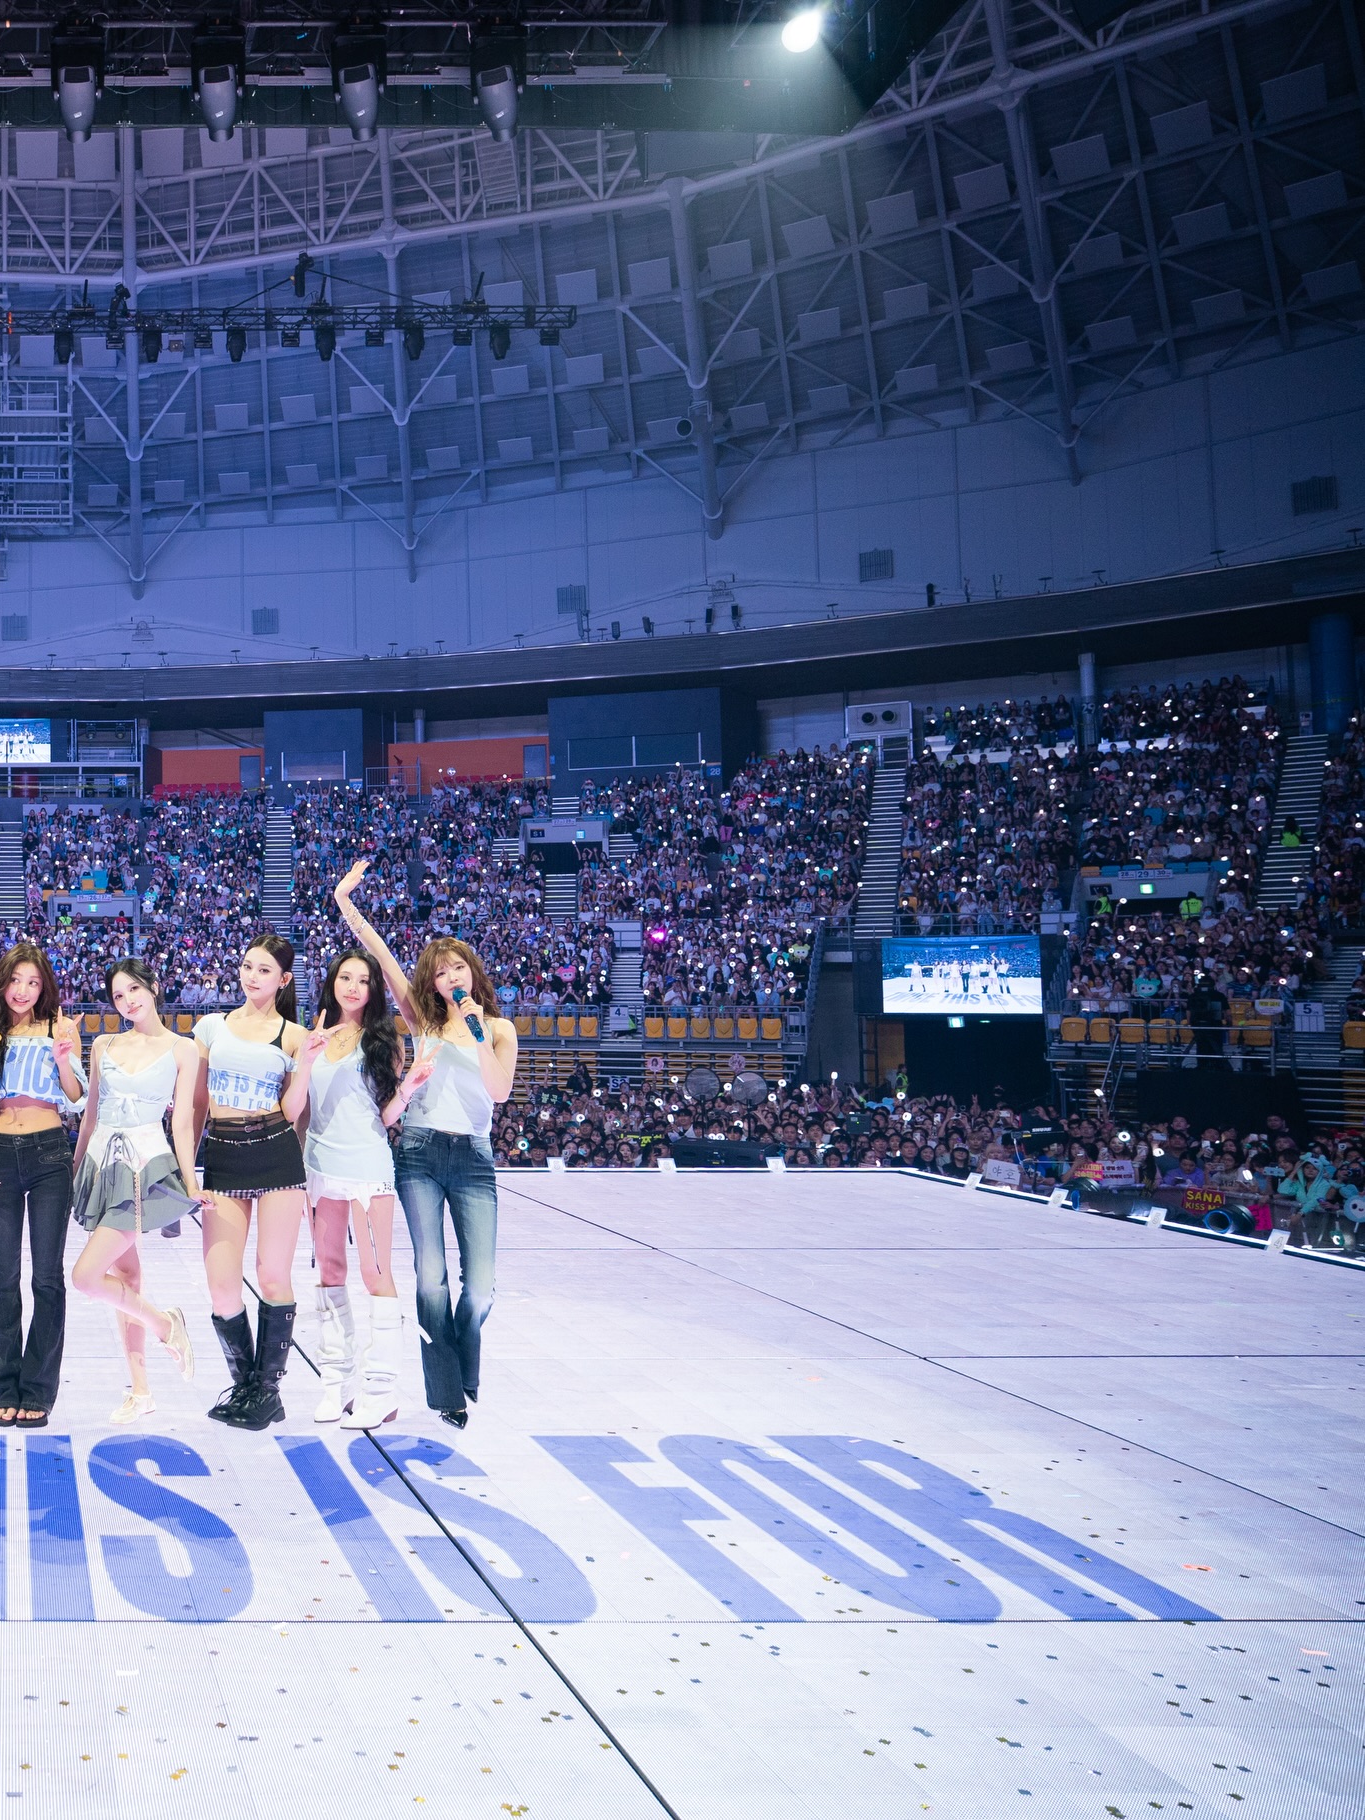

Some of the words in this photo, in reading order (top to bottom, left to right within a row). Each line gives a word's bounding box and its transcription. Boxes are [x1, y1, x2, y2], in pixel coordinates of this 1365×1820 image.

[1082, 702, 1096, 714] 29
[710, 767, 721, 776] 28
[117, 778, 127, 786] 26
[1138, 870, 1149, 878] 29
[940, 993, 980, 1005] THIS
[987, 994, 1009, 1006] IS
[614, 1007, 621, 1017] 4
[1303, 1003, 1312, 1014] 5
[208, 1067, 229, 1092] HIS
[234, 1073, 250, 1093] IS
[1186, 1190, 1223, 1204] SANA
[1185, 1201, 1205, 1211] KISS
[1273, 1236, 1284, 1249] 4
[274, 1434, 597, 1625] IS
[530, 1434, 1225, 1625] FOR
